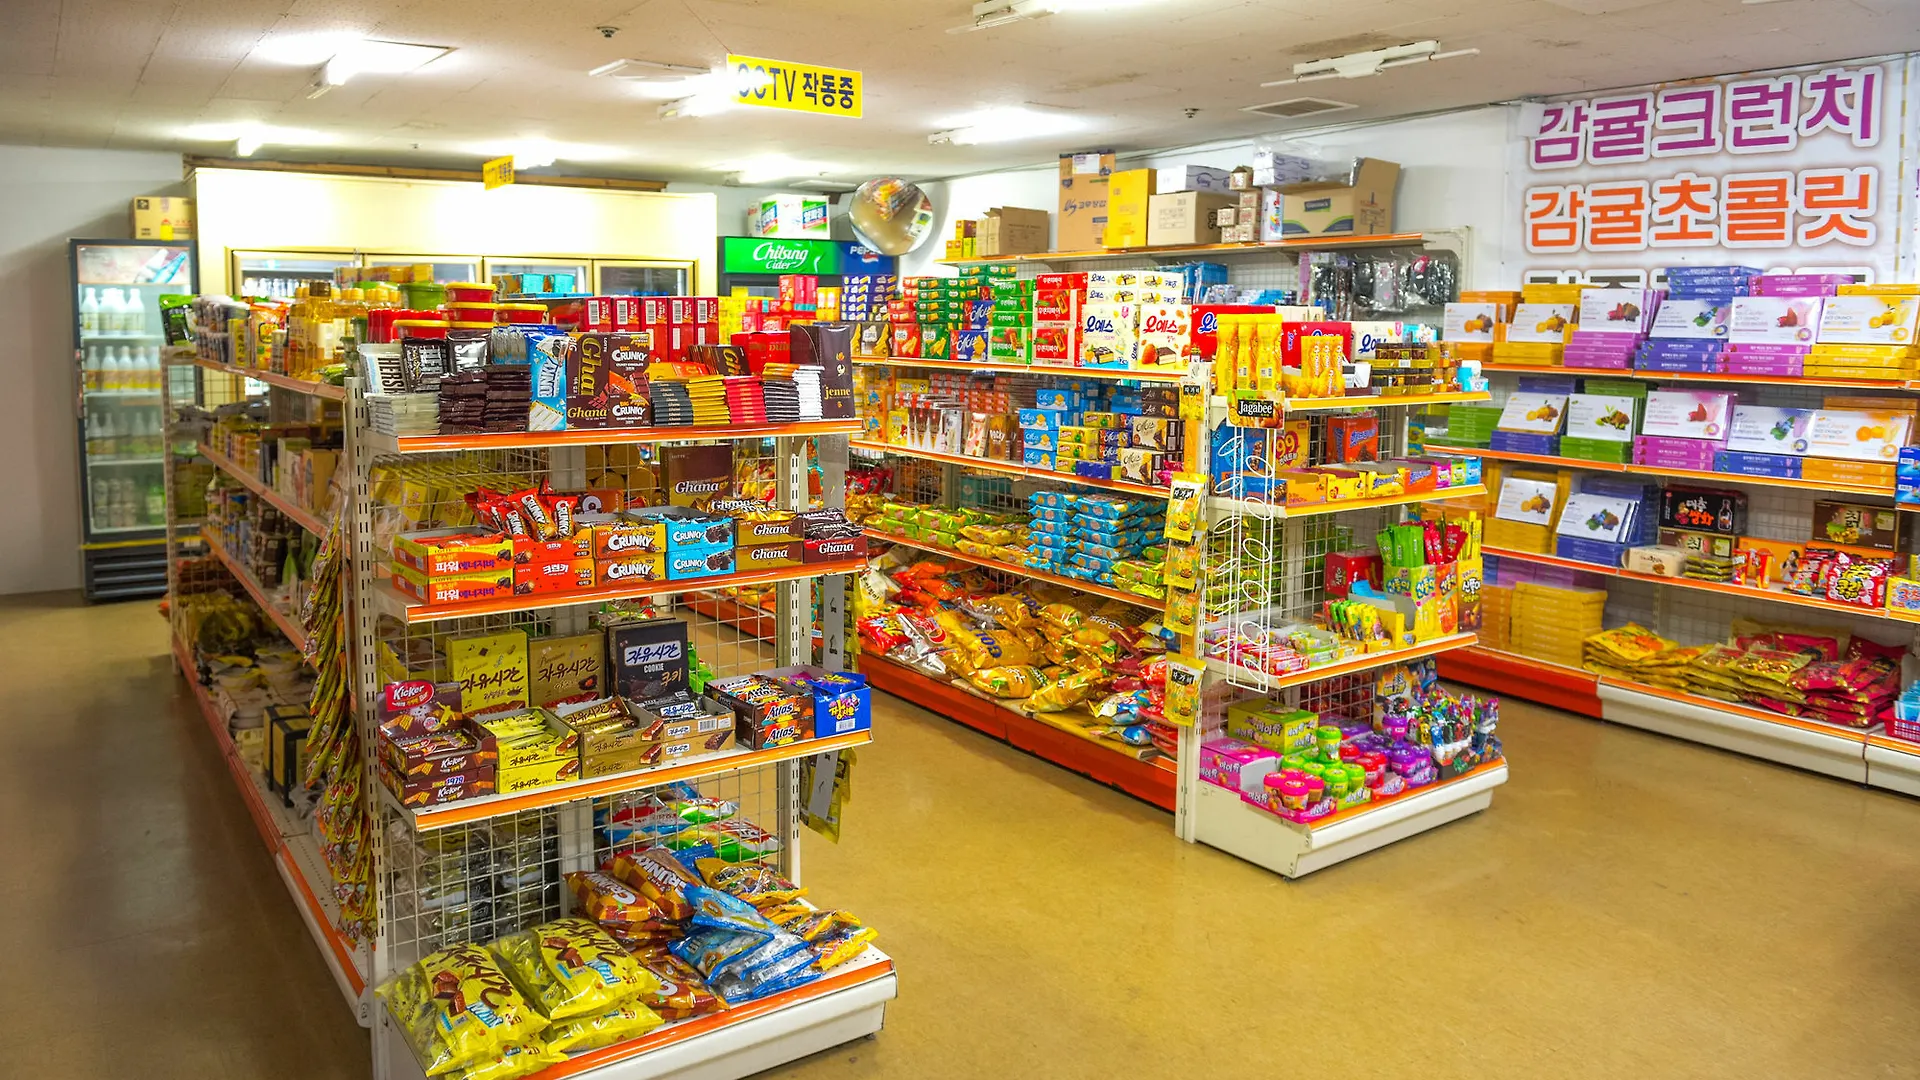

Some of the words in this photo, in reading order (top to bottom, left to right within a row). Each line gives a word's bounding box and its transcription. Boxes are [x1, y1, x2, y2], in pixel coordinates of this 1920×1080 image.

[802, 72, 854, 109] 작동중
[1539, 73, 1875, 163] 감귤크런치
[1530, 174, 1871, 247] 감귤초콜릿
[753, 242, 809, 268] Chilsung
[766, 260, 792, 269] Cider
[1084, 315, 1114, 334] 오예스
[1143, 316, 1178, 334] 오예스
[611, 350, 648, 363] CRUNKY
[378, 357, 406, 394] HERS
[823, 385, 851, 400] jenne
[567, 406, 608, 419] Ghana
[612, 406, 646, 417] CRUNKY
[1238, 401, 1273, 415] Jagabee
[1276, 433, 1296, 458] 99
[675, 481, 719, 494] Ghana
[521, 494, 545, 524] CRUNKY
[506, 510, 524, 536] CRUNK
[555, 500, 569, 537] CRUNKY
[672, 531, 704, 542] CRUNKY
[753, 523, 790, 536] Ghana
[608, 534, 654, 552] CRUNKY
[818, 542, 855, 555] Ghana
[751, 549, 788, 561] Ghana
[542, 563, 569, 575] 크런키
[607, 563, 653, 579] CRUNKY
[673, 558, 705, 570] CRUNKY
[626, 643, 681, 663] 자유시간
[538, 656, 600, 683] 자유시간
[643, 663, 665, 673] COOKIE
[460, 667, 524, 693] 자유시간
[393, 685, 425, 700] Kicker
[770, 703, 794, 719] Atlas
[770, 727, 795, 742] Atlas
[441, 755, 465, 768] Kicker
[509, 752, 541, 767] 자유시간
[446, 775, 464, 785] 1979
[510, 776, 541, 791] 자유시간
[438, 785, 462, 798] Kicker
[466, 1000, 504, 1029] Mini
